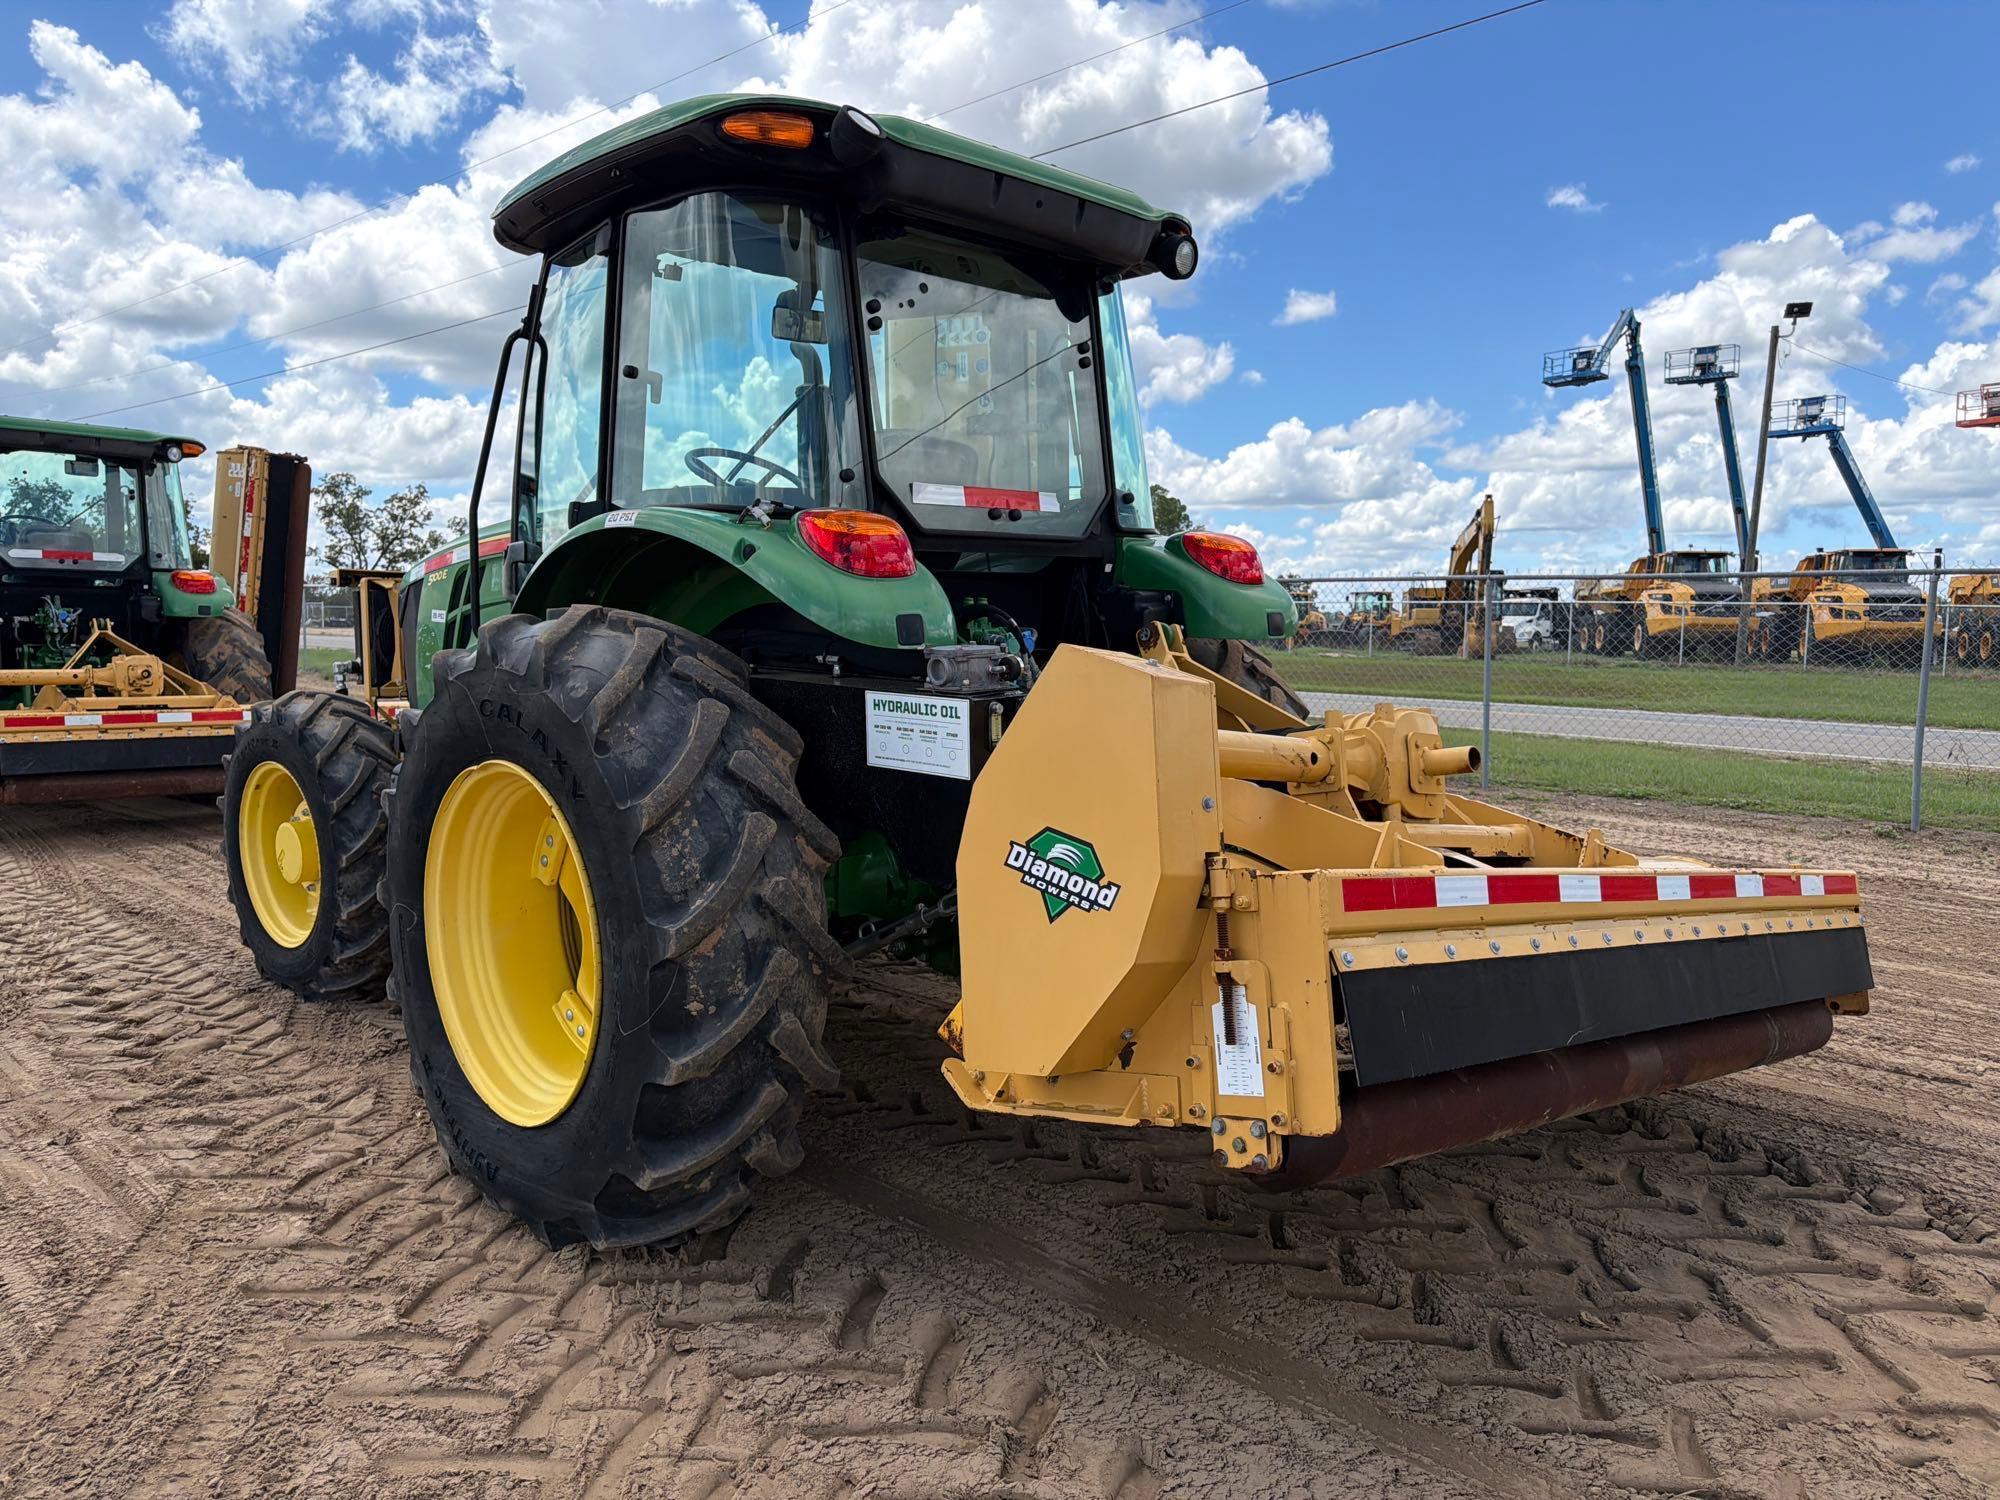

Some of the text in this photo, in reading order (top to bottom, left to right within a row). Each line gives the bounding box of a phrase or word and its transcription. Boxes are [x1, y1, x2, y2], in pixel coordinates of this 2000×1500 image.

[608, 512, 634, 522] 20 PSI
[873, 699, 960, 719] HYDRAULIC OIL
[1007, 843, 1118, 908] Diamond
[1023, 875, 1090, 909] MOWERS
